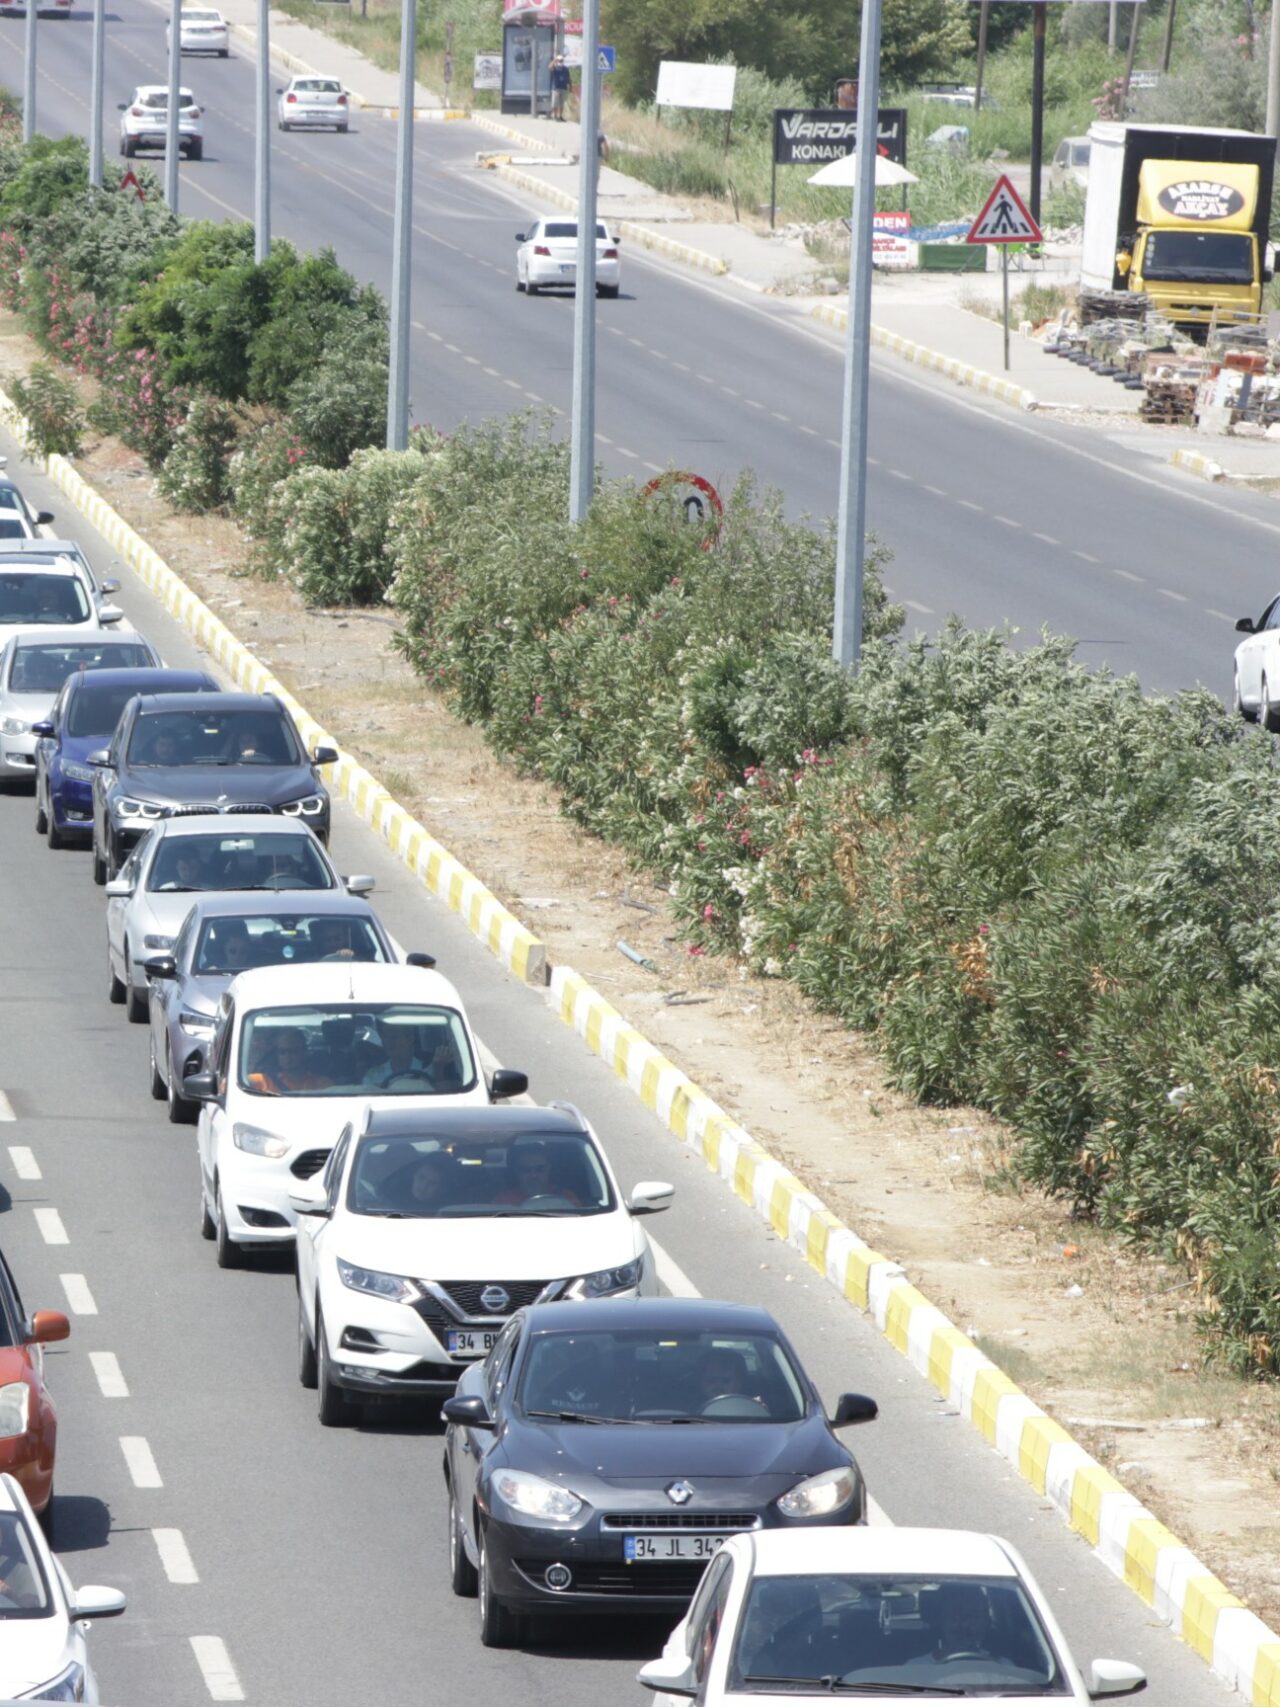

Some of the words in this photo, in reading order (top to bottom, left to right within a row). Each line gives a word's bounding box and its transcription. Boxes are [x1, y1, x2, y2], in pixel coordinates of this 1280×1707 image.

[782, 113, 898, 138] VARDALI
[792, 145, 857, 159] KONAKL
[458, 1334, 474, 1350] 34
[636, 1539, 656, 1557] 34
[666, 1539, 685, 1557] JL
